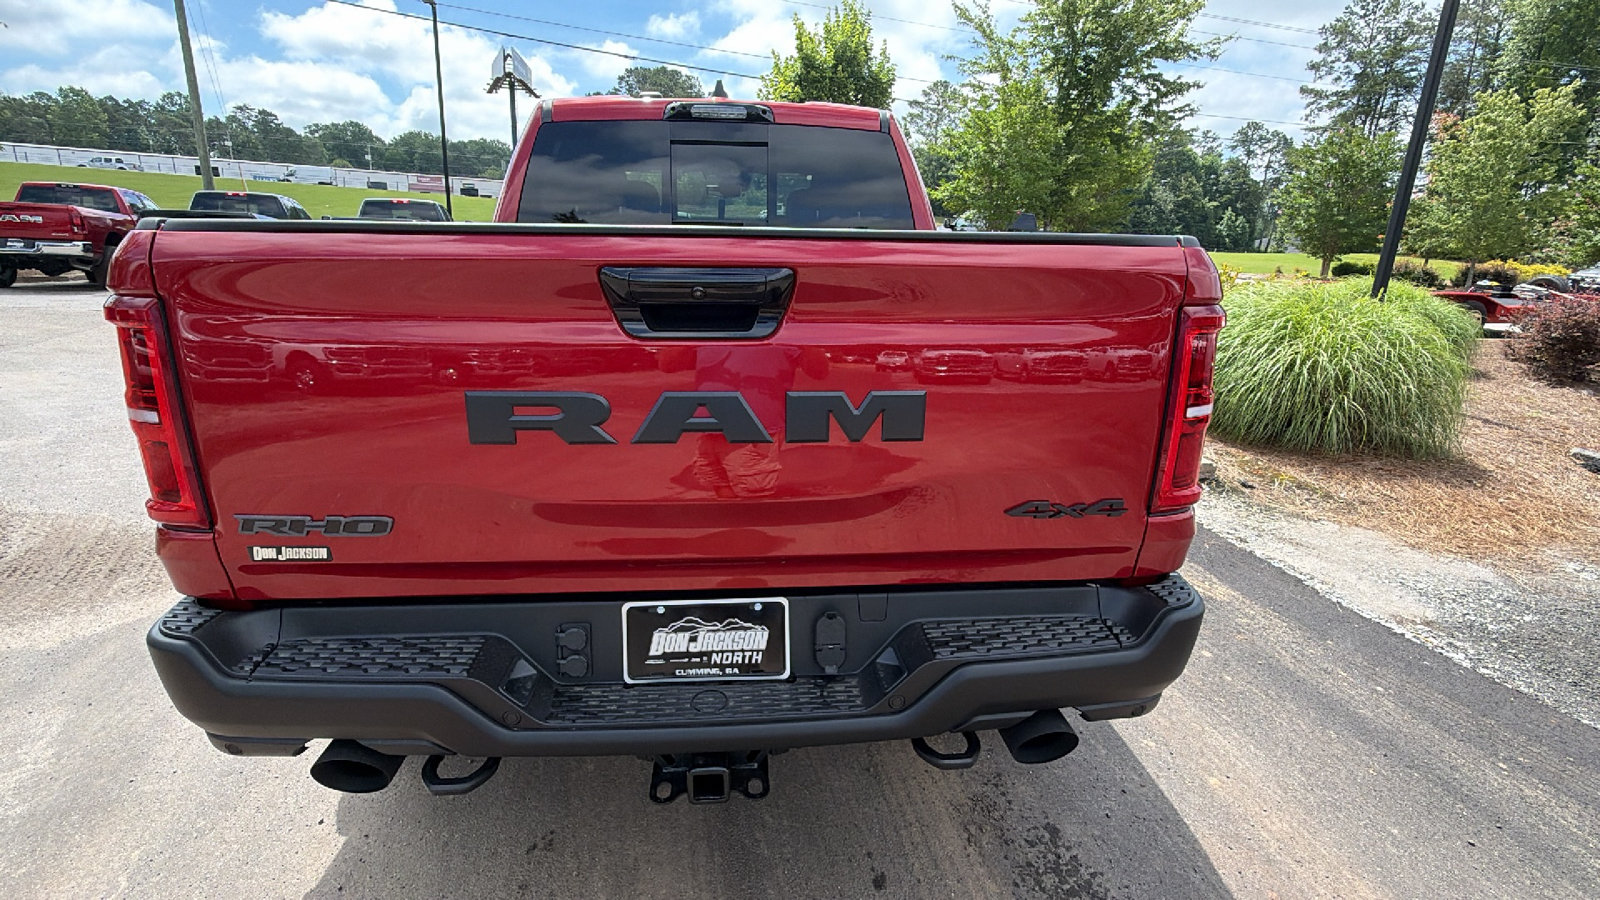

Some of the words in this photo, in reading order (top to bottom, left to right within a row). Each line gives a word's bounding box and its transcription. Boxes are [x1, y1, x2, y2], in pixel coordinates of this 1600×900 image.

[465, 390, 928, 446] RAM
[233, 514, 394, 536] RHO
[252, 546, 278, 561] DON
[278, 546, 328, 560] JACKSON
[648, 630, 690, 656] DON
[688, 629, 769, 653] JACKSON
[711, 651, 763, 665] NORTH
[675, 668, 723, 676] CUMMING,
[725, 667, 740, 675] GA
